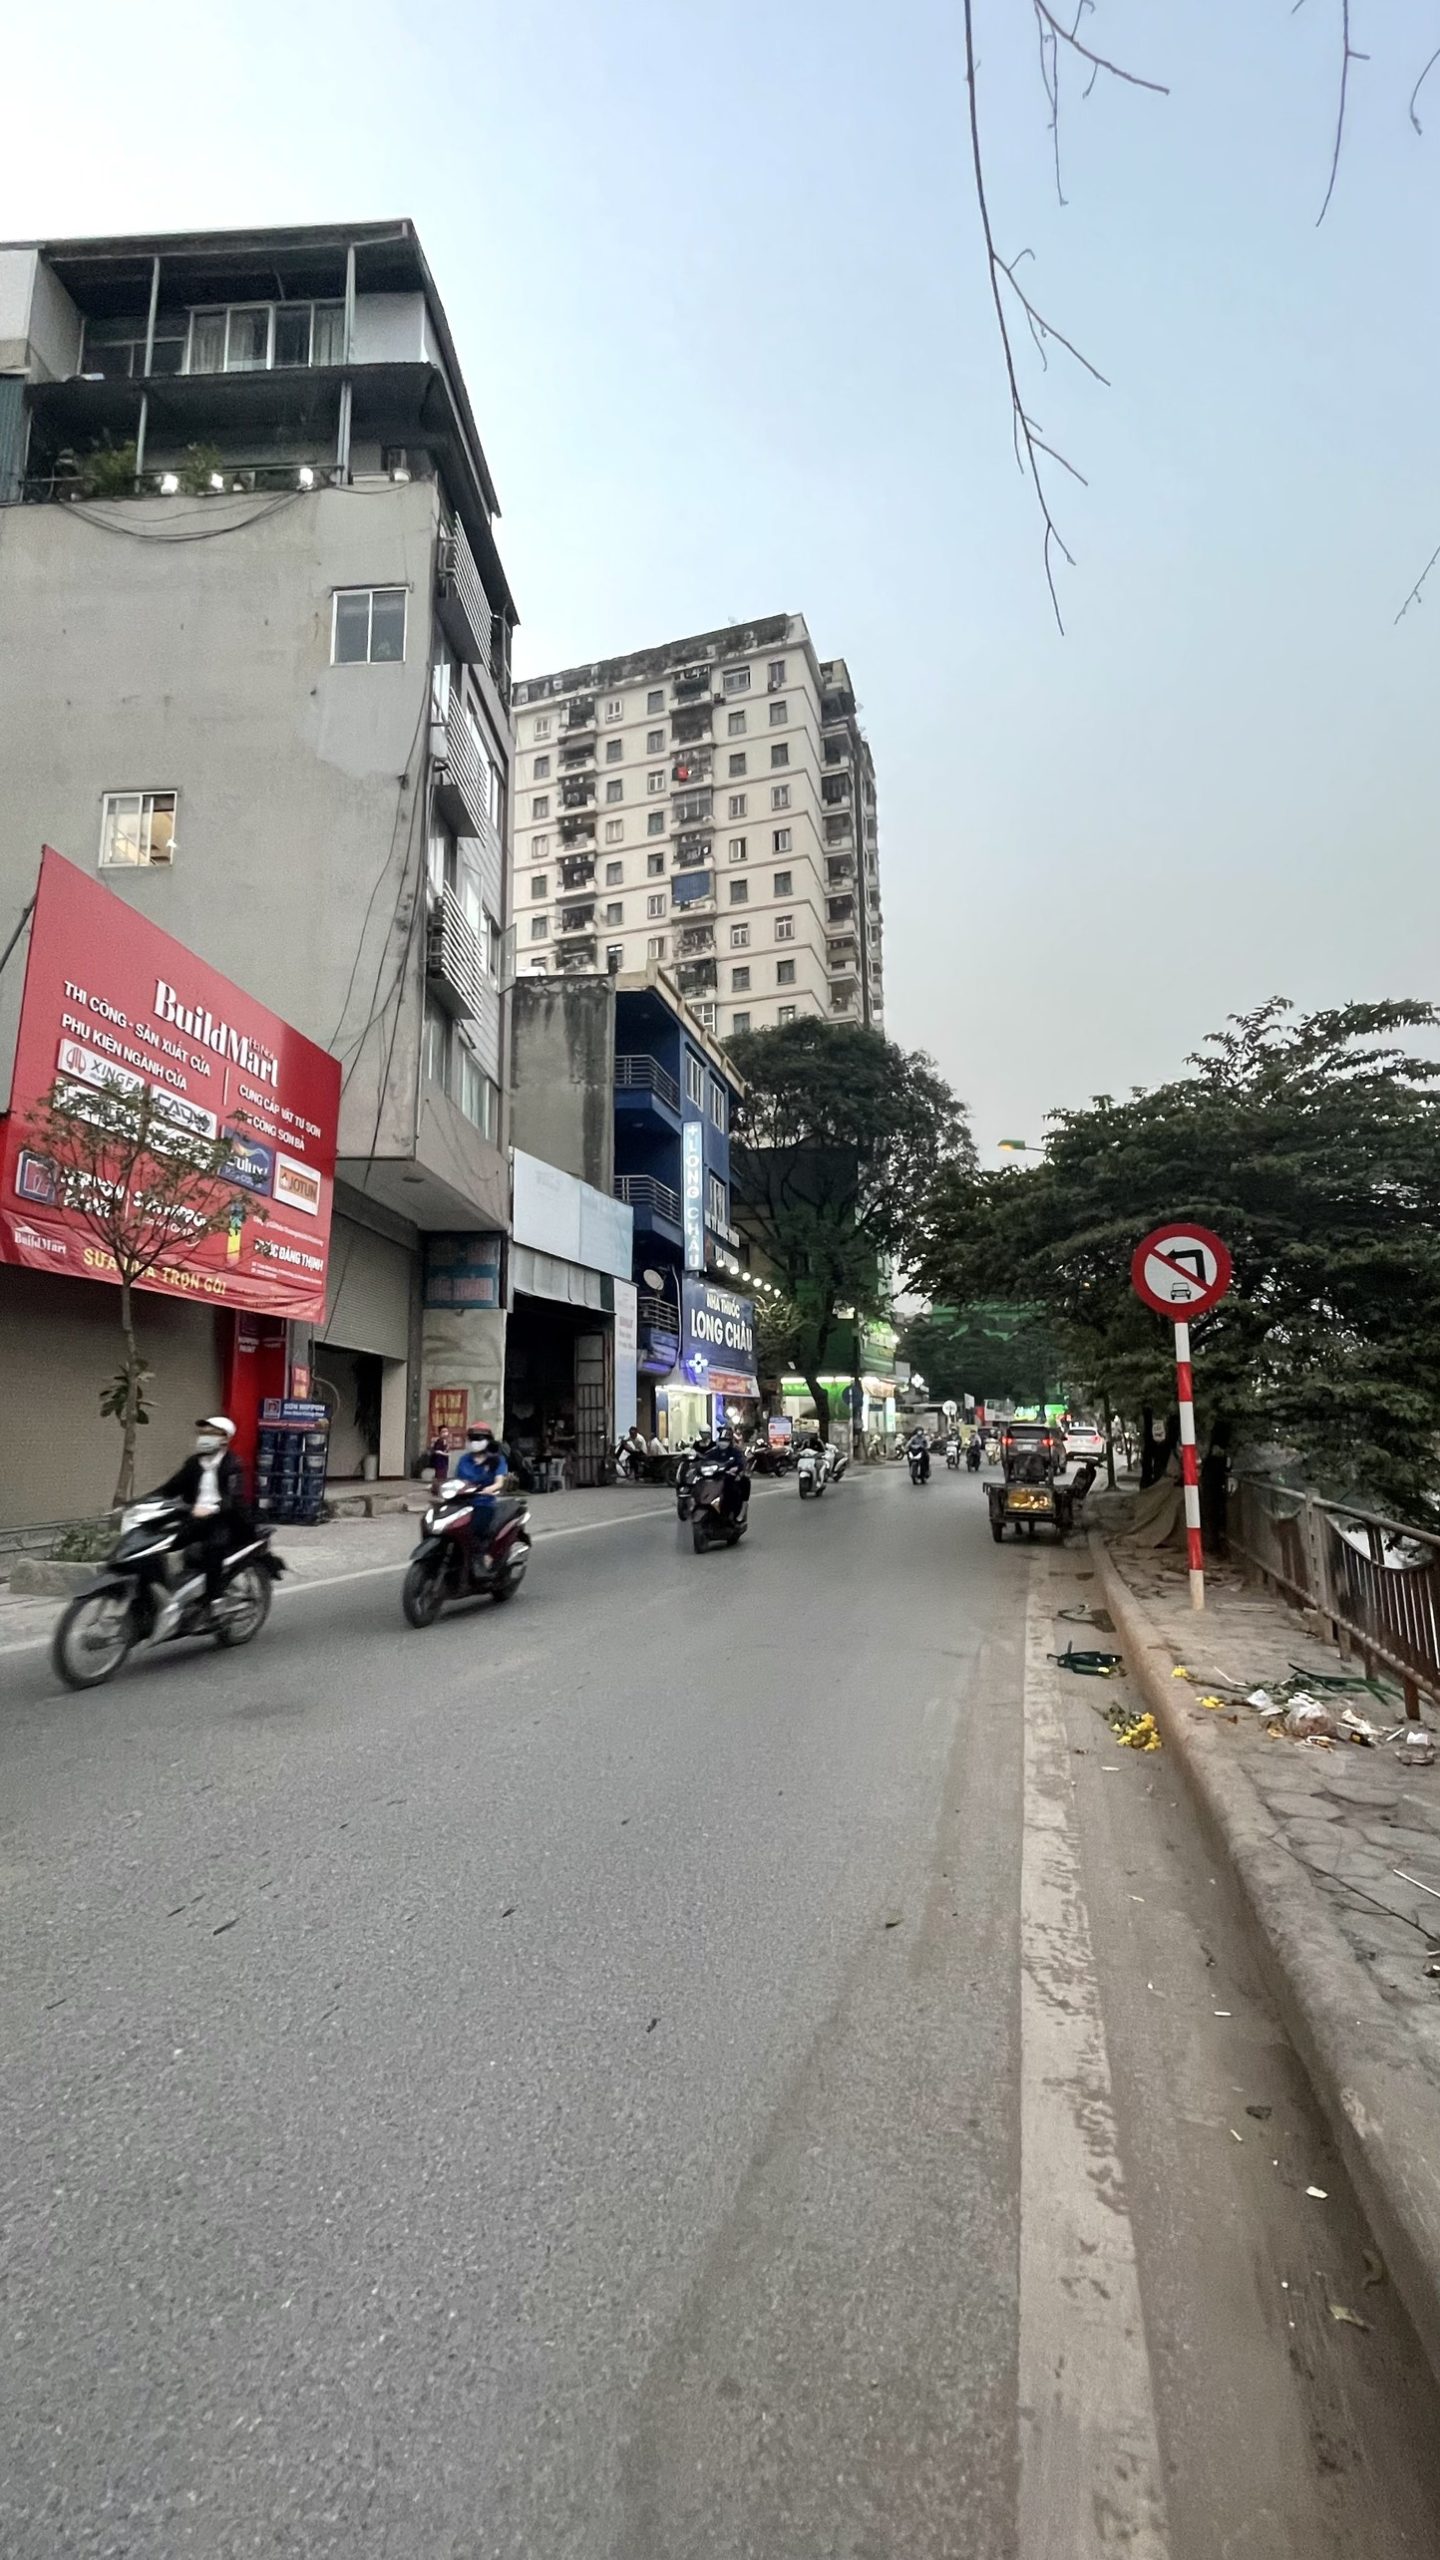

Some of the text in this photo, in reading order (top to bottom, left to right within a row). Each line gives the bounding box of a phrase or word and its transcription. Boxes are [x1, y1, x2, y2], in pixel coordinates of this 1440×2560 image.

[61, 1013, 91, 1042] PHỤ
[92, 1029, 122, 1056] KIỆN
[123, 1046, 164, 1078] NGÀNH
[64, 980, 87, 1005] THI
[89, 996, 128, 1028] CÔNG
[135, 1023, 160, 1047] SẢN
[162, 1038, 190, 1063] XUẤT
[153, 978, 278, 1088] BuildMart
[239, 1084, 263, 1107] CUNG
[263, 1095, 280, 1115] CẤP
[252, 1115, 277, 1137] CÔNG
[686, 1136, 700, 1199] LONG
[690, 1308, 753, 1352] LONG CHÂU
